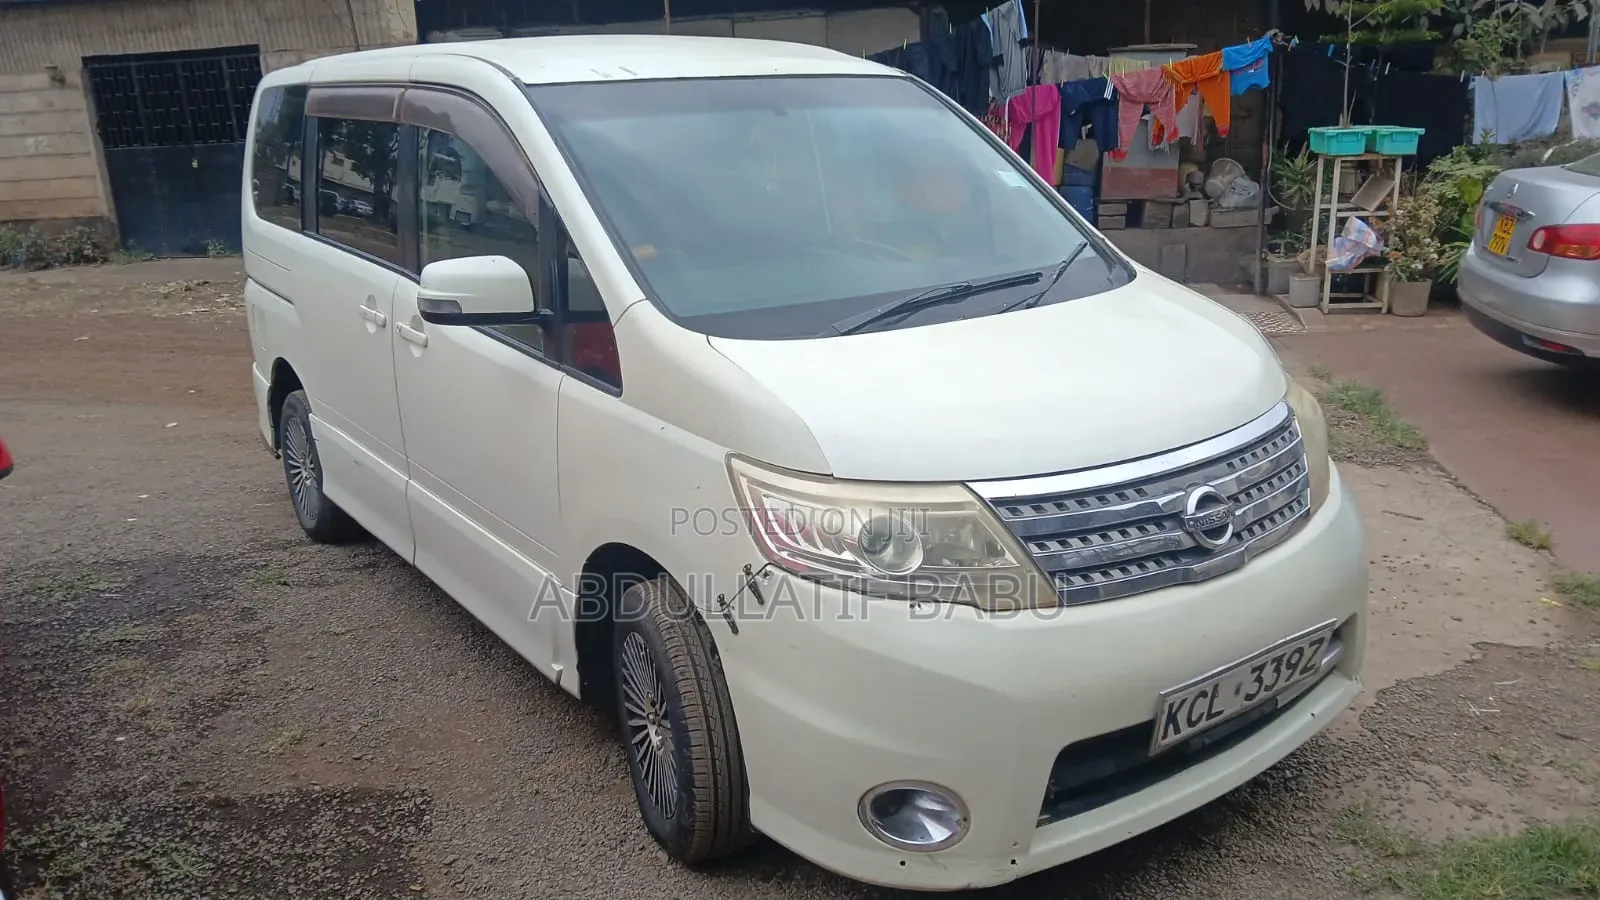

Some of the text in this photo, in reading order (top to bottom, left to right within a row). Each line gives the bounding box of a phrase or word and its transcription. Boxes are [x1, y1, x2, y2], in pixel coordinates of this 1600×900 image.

[1195, 508, 1234, 529] NISSAN
[1161, 636, 1326, 740] KCL 339Z
